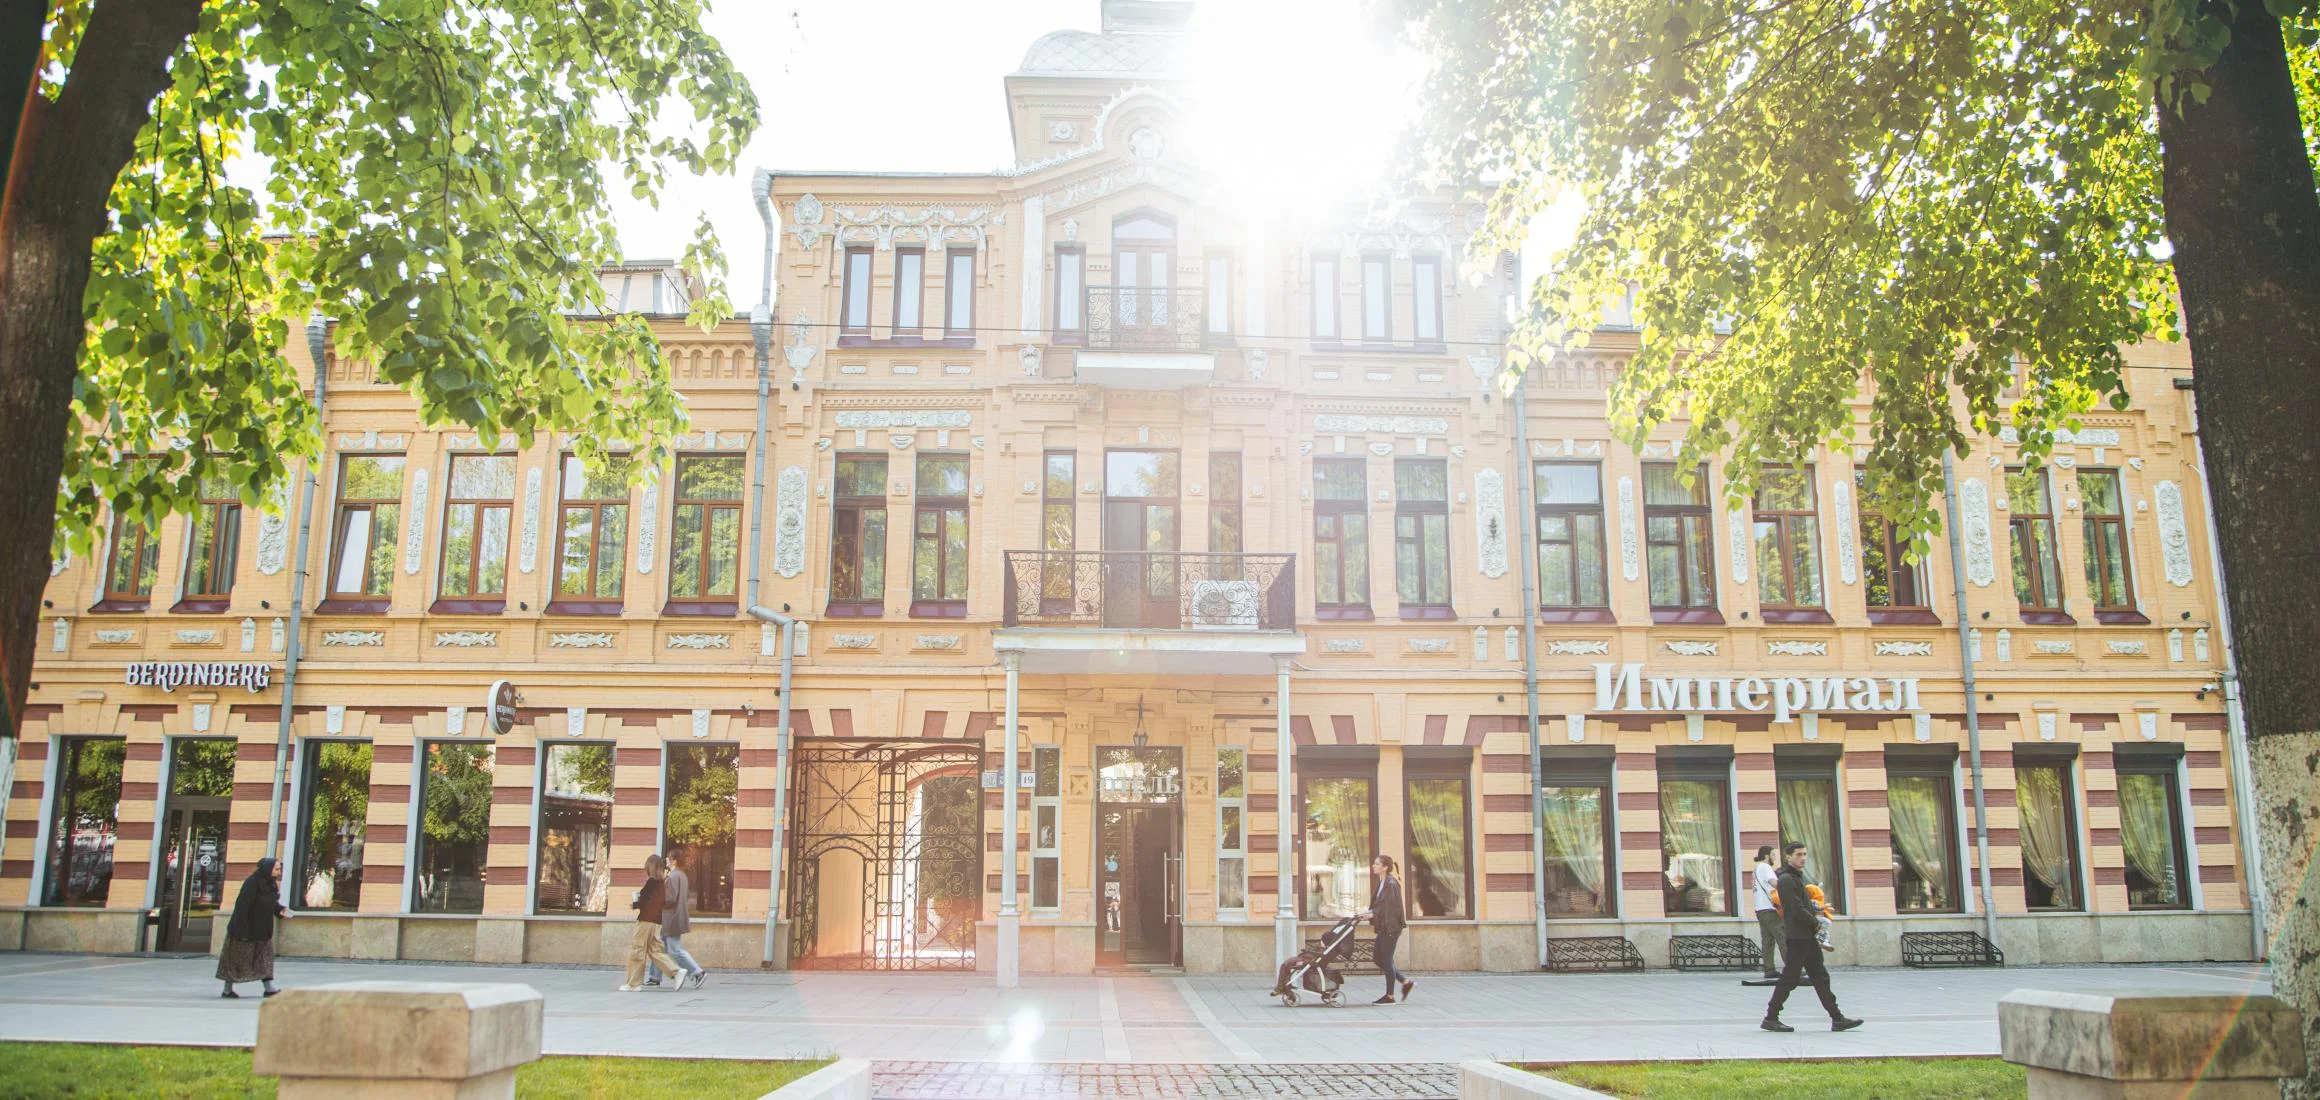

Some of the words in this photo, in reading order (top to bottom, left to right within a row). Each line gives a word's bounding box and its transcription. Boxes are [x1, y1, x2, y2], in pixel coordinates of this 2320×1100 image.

[126, 662, 271, 693] BERDINBERG
[1592, 662, 1922, 723] Империал
[1023, 775, 1034, 784] 19
